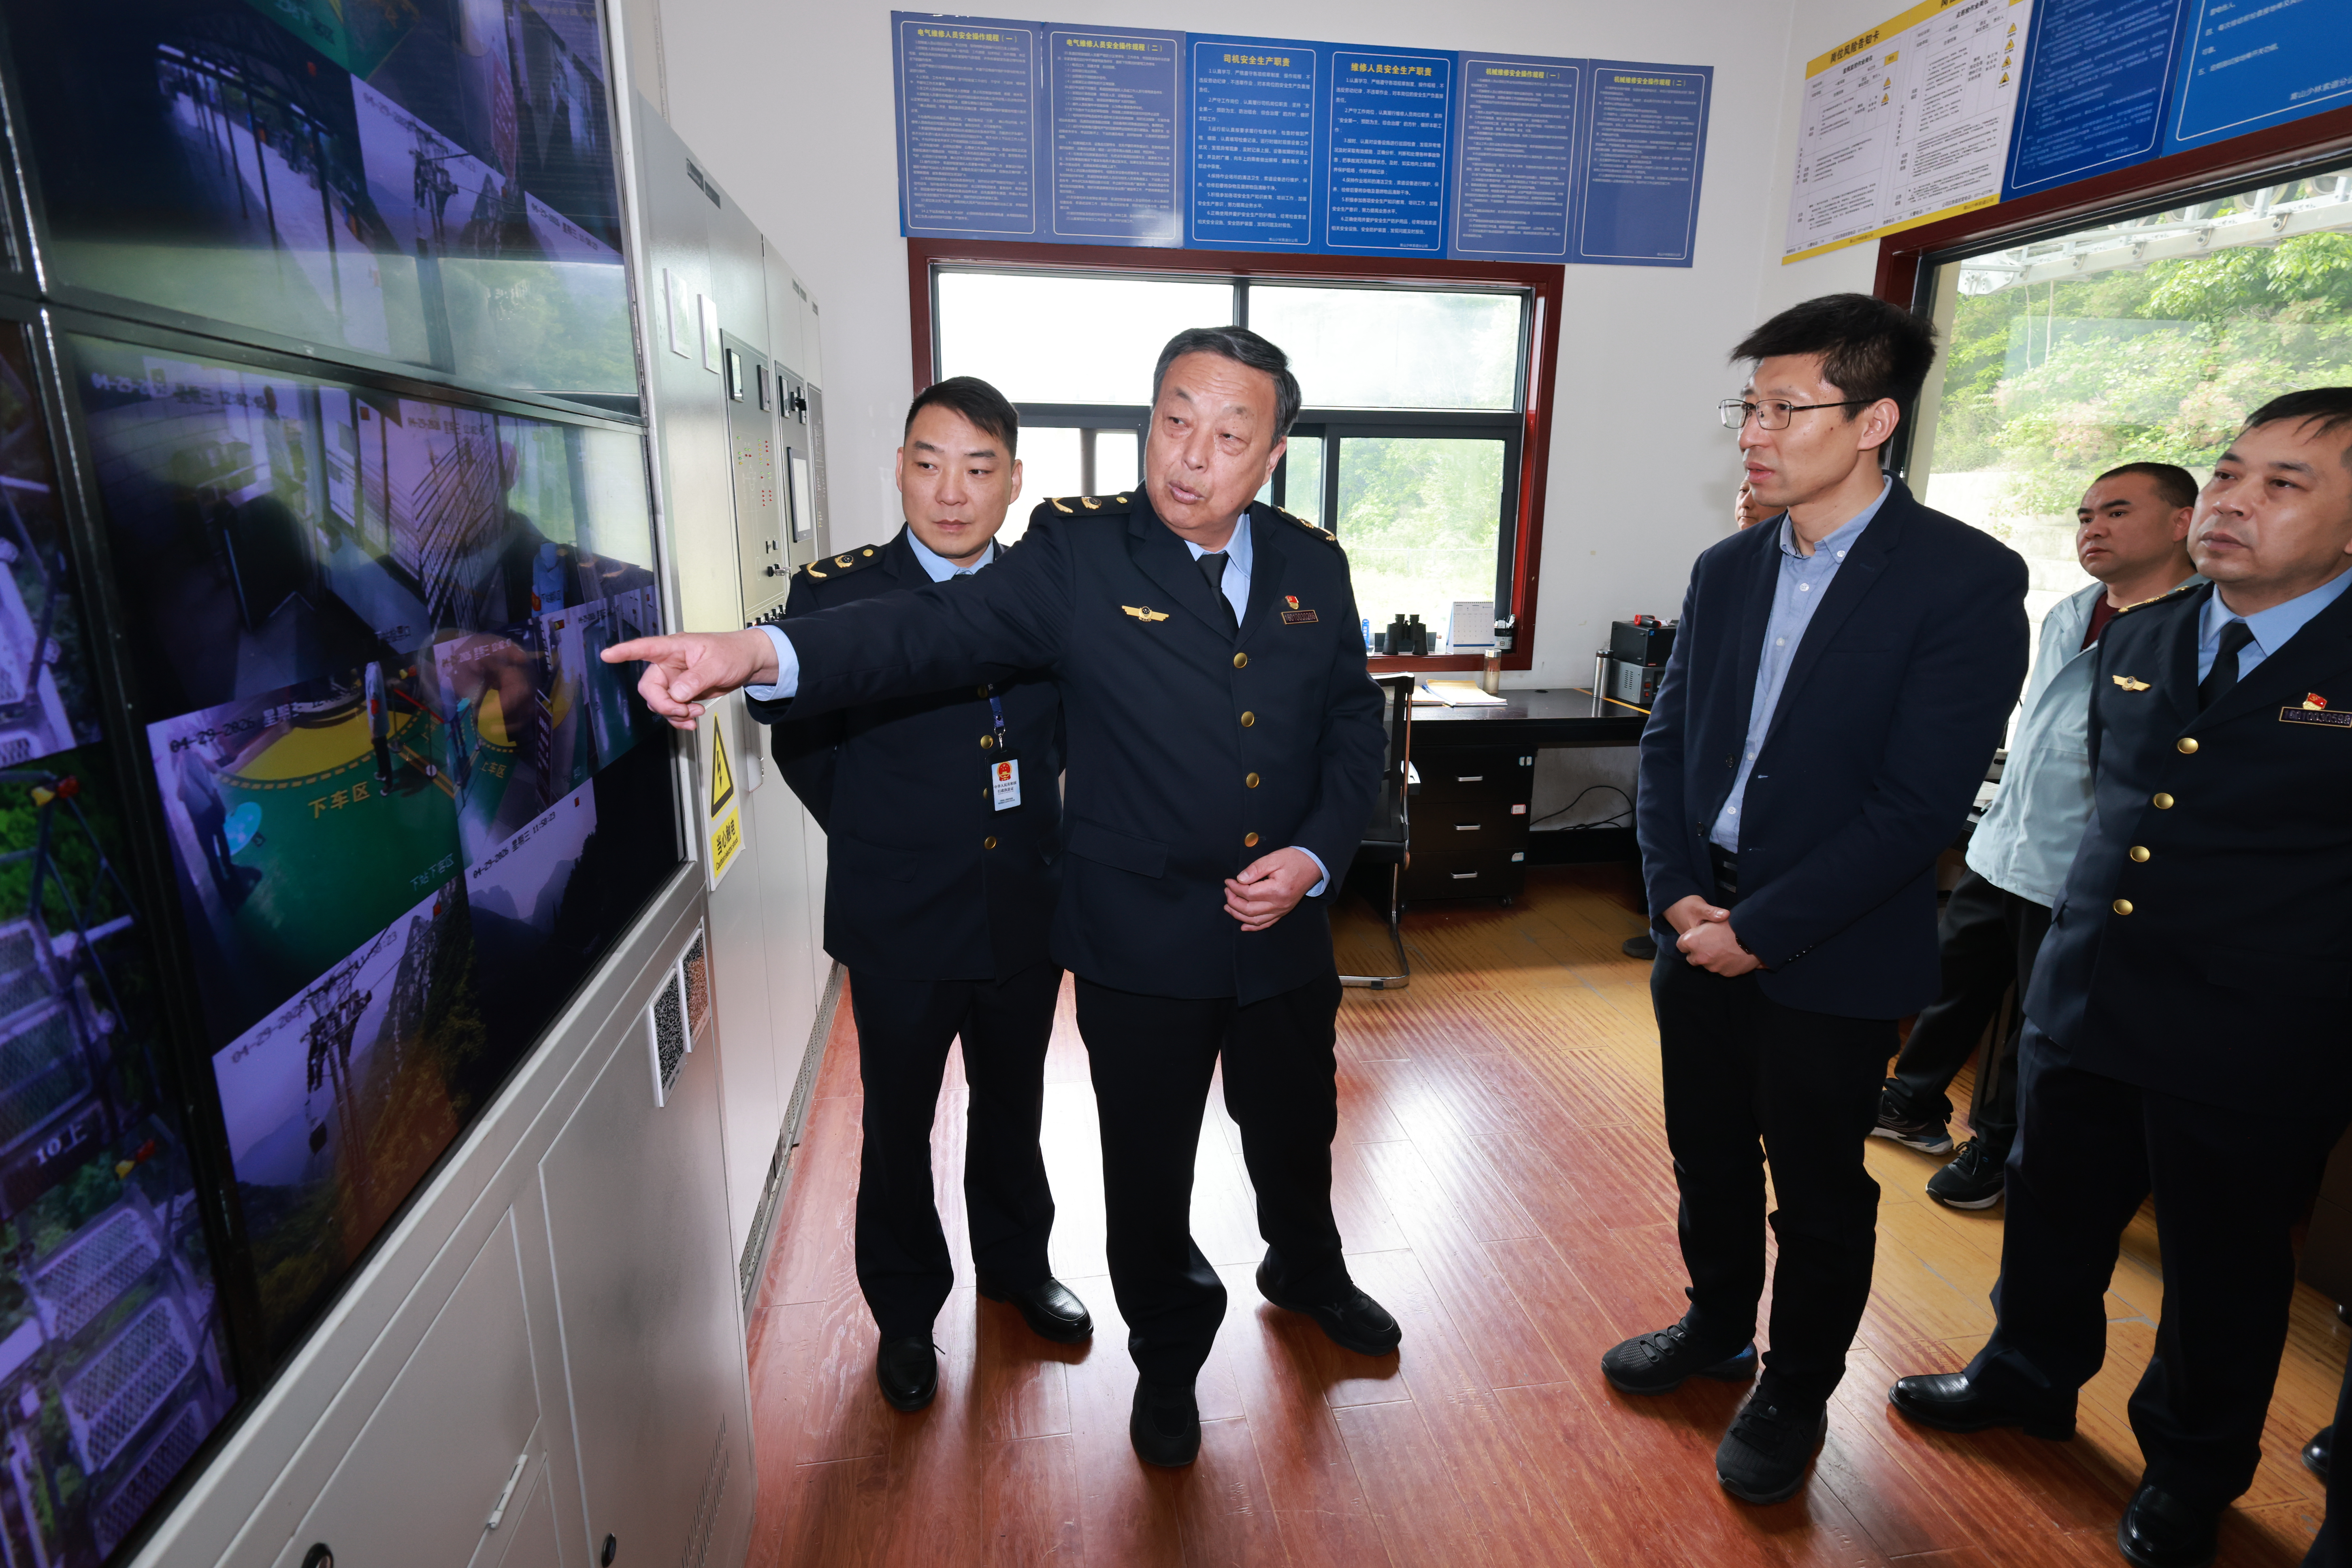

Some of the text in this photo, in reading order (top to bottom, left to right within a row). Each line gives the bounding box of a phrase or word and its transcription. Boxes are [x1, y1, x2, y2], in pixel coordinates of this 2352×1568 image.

[1830, 28, 1880, 64] 岗位风险告知卡
[1223, 54, 1290, 67] 司机安全生产职责
[1351, 62, 1432, 76] 维修人员安全生产职责
[994, 781, 1017, 789] 中华人民共和国
[307, 781, 371, 820] 下车区
[716, 818, 736, 856] 当心触电
